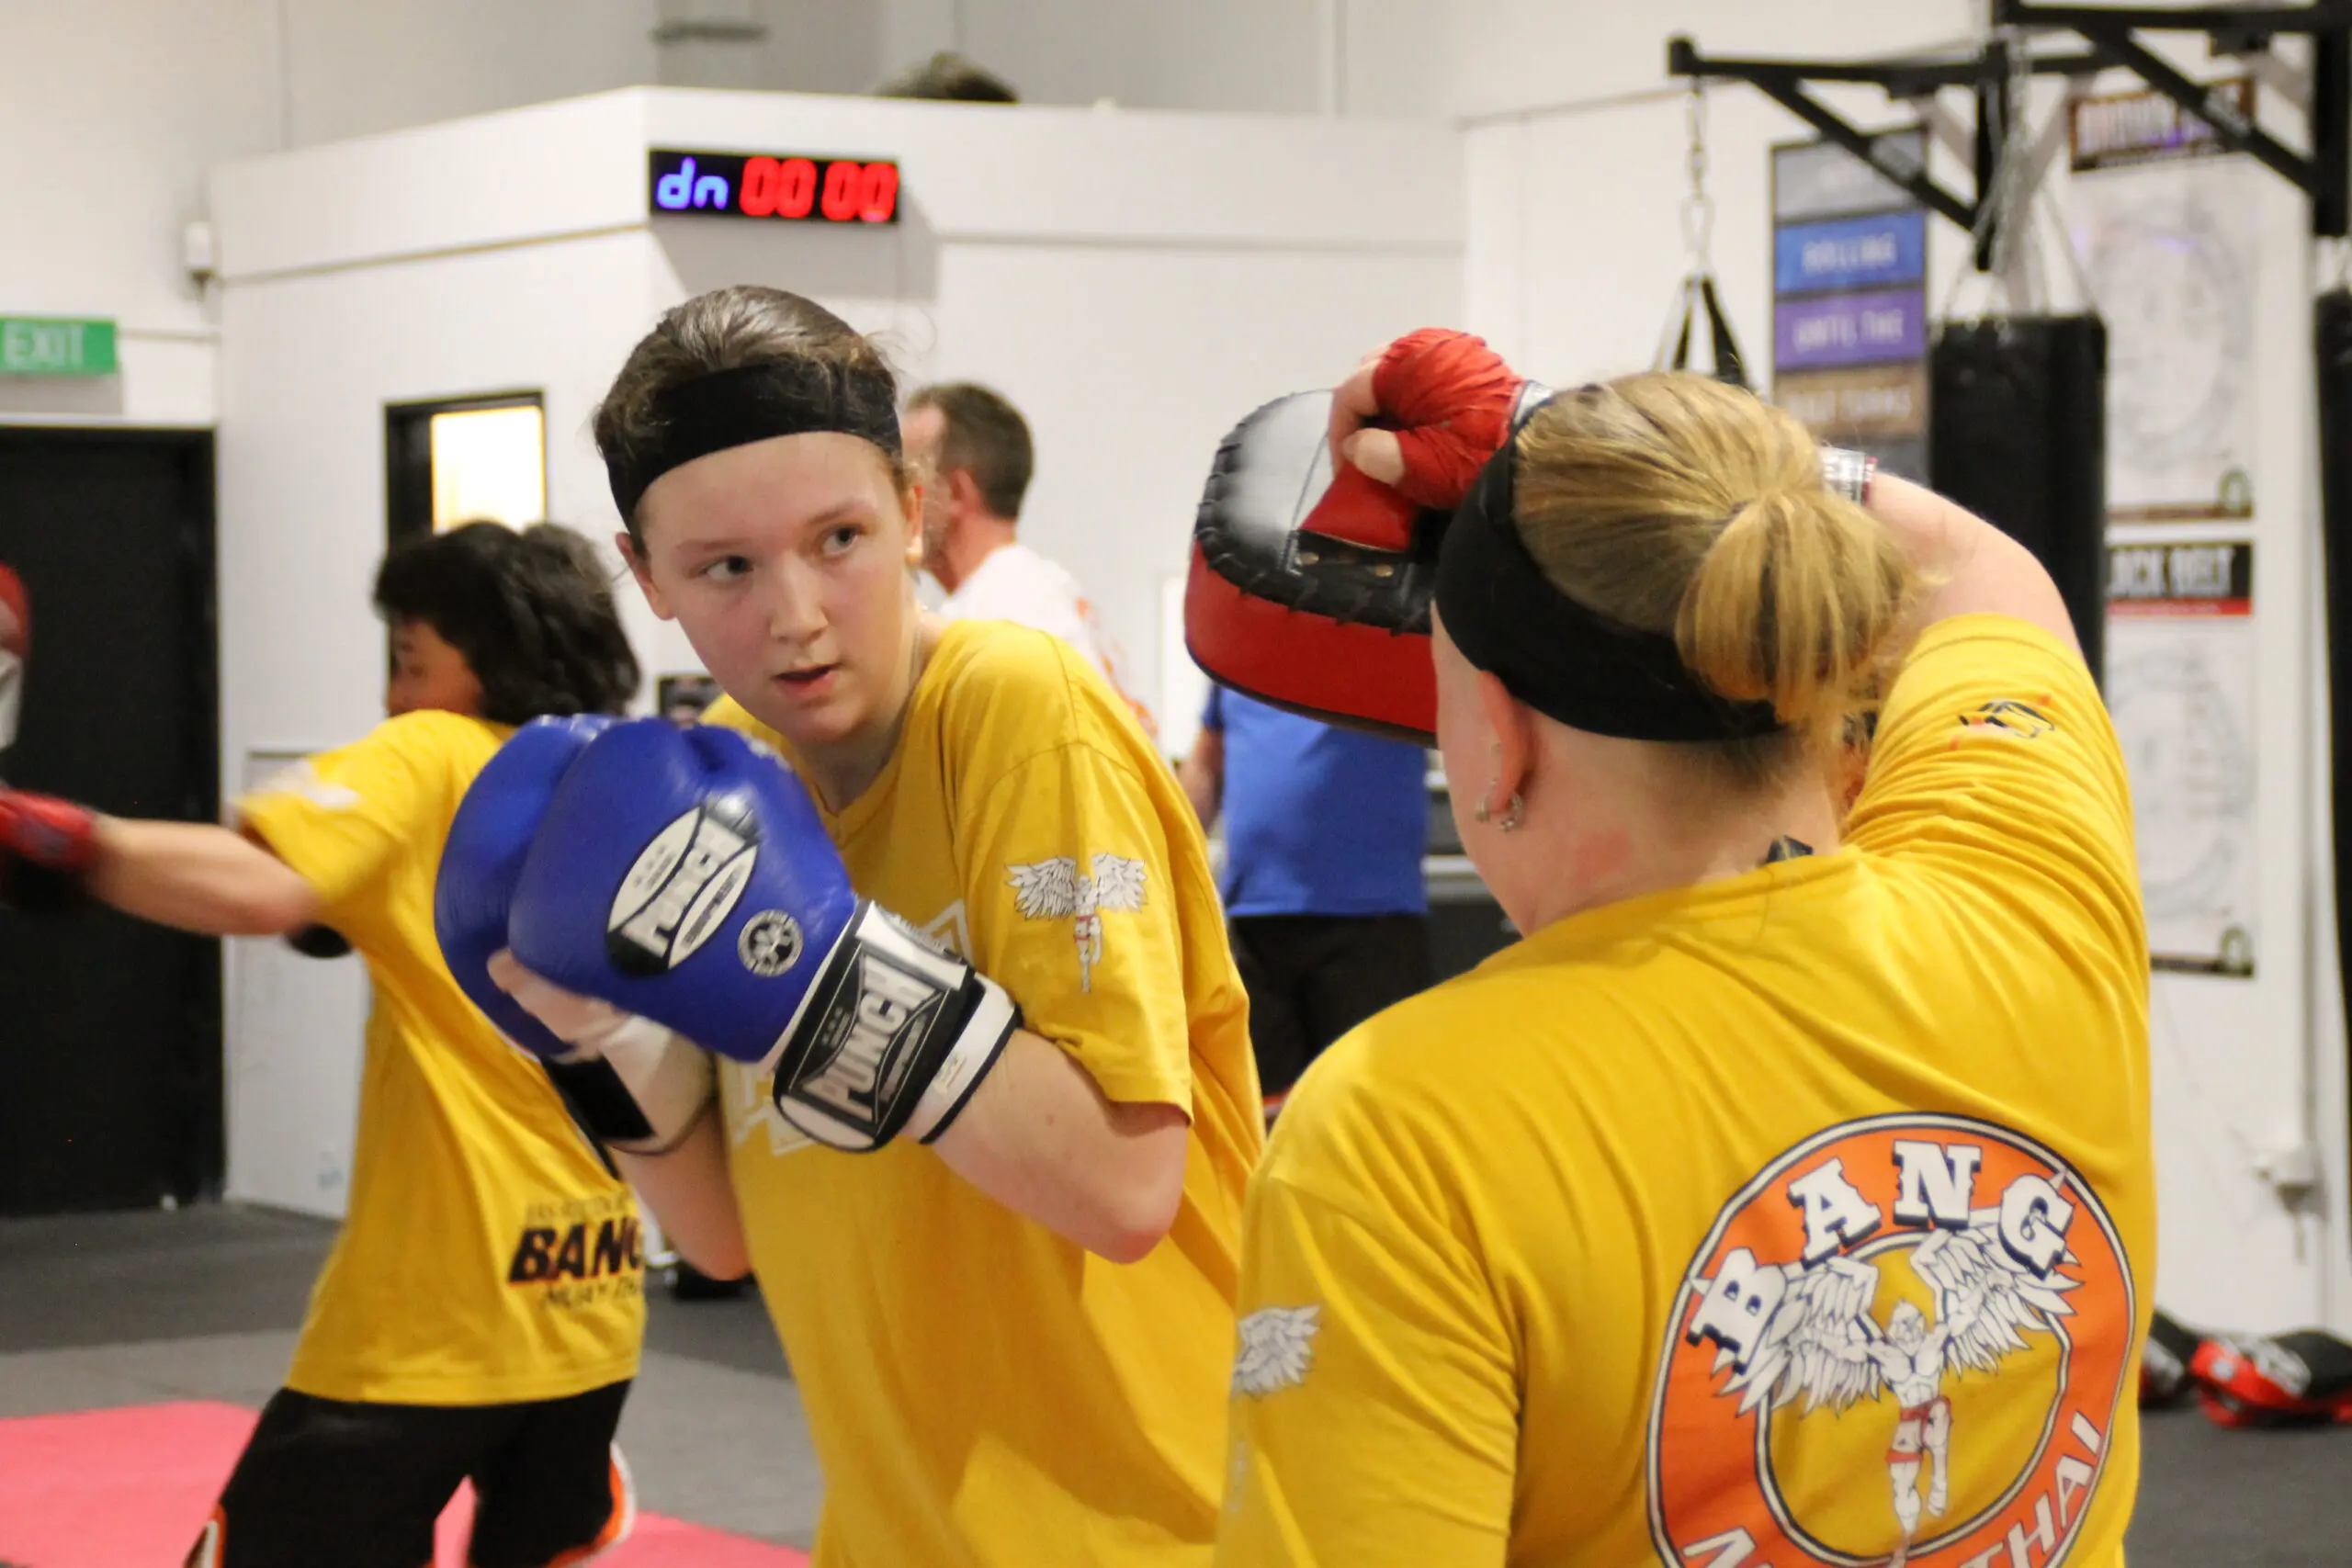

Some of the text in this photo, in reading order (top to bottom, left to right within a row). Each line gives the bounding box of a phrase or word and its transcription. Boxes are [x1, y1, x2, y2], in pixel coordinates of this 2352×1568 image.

[657, 157, 729, 209] dn
[4, 321, 84, 369] EXIT
[620, 816, 747, 959] PUNCH
[802, 953, 938, 1122] PUNCH
[1686, 1139, 2076, 1375] BANG
